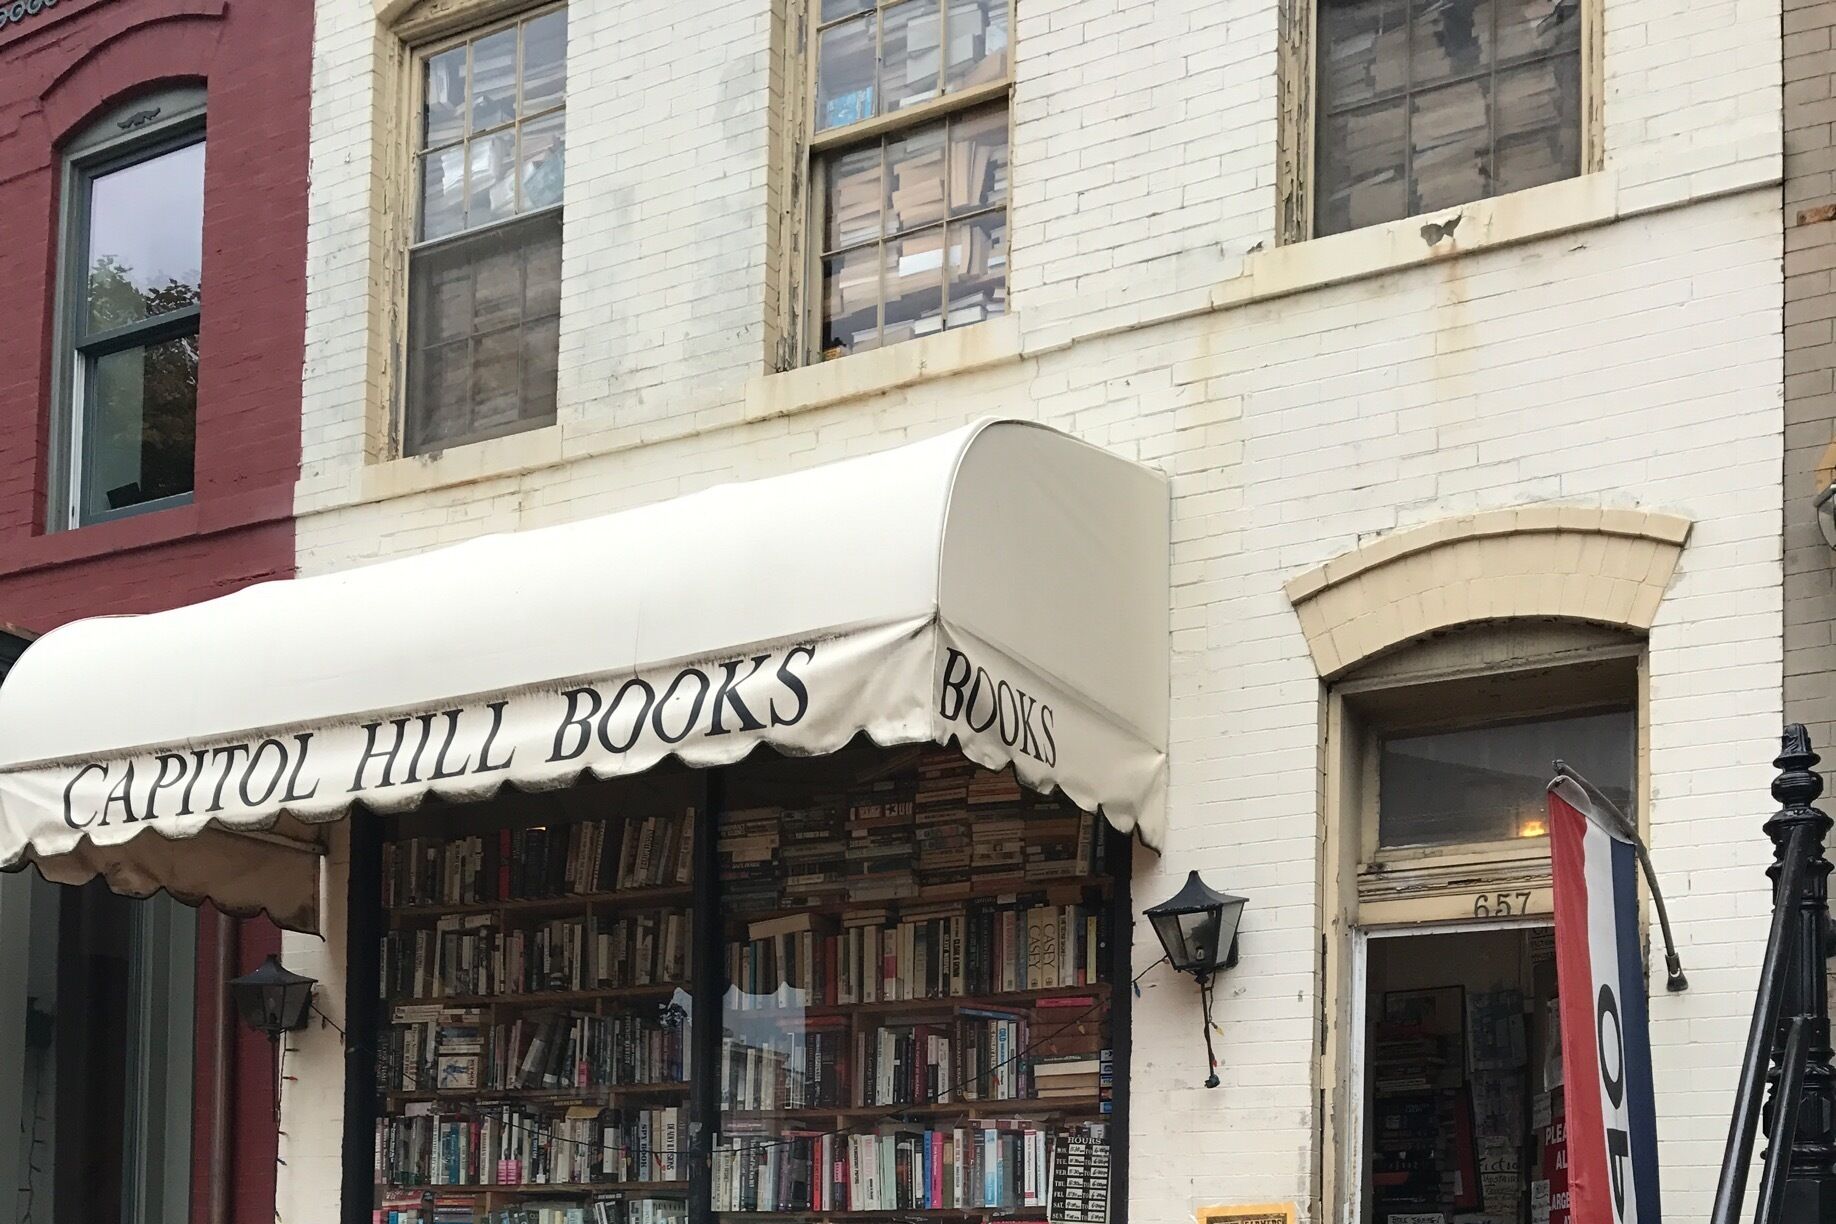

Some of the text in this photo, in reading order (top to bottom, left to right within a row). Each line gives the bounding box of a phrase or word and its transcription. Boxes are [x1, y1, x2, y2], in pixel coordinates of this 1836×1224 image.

[939, 645, 1058, 769] BOOKS
[63, 645, 817, 830] CAPITOL HILL BOOKS
[1474, 891, 1531, 917] 657
[1028, 924, 1040, 970] CASEY
[1043, 923, 1056, 968] CASEY
[1067, 1136, 1102, 1145] HOURS
